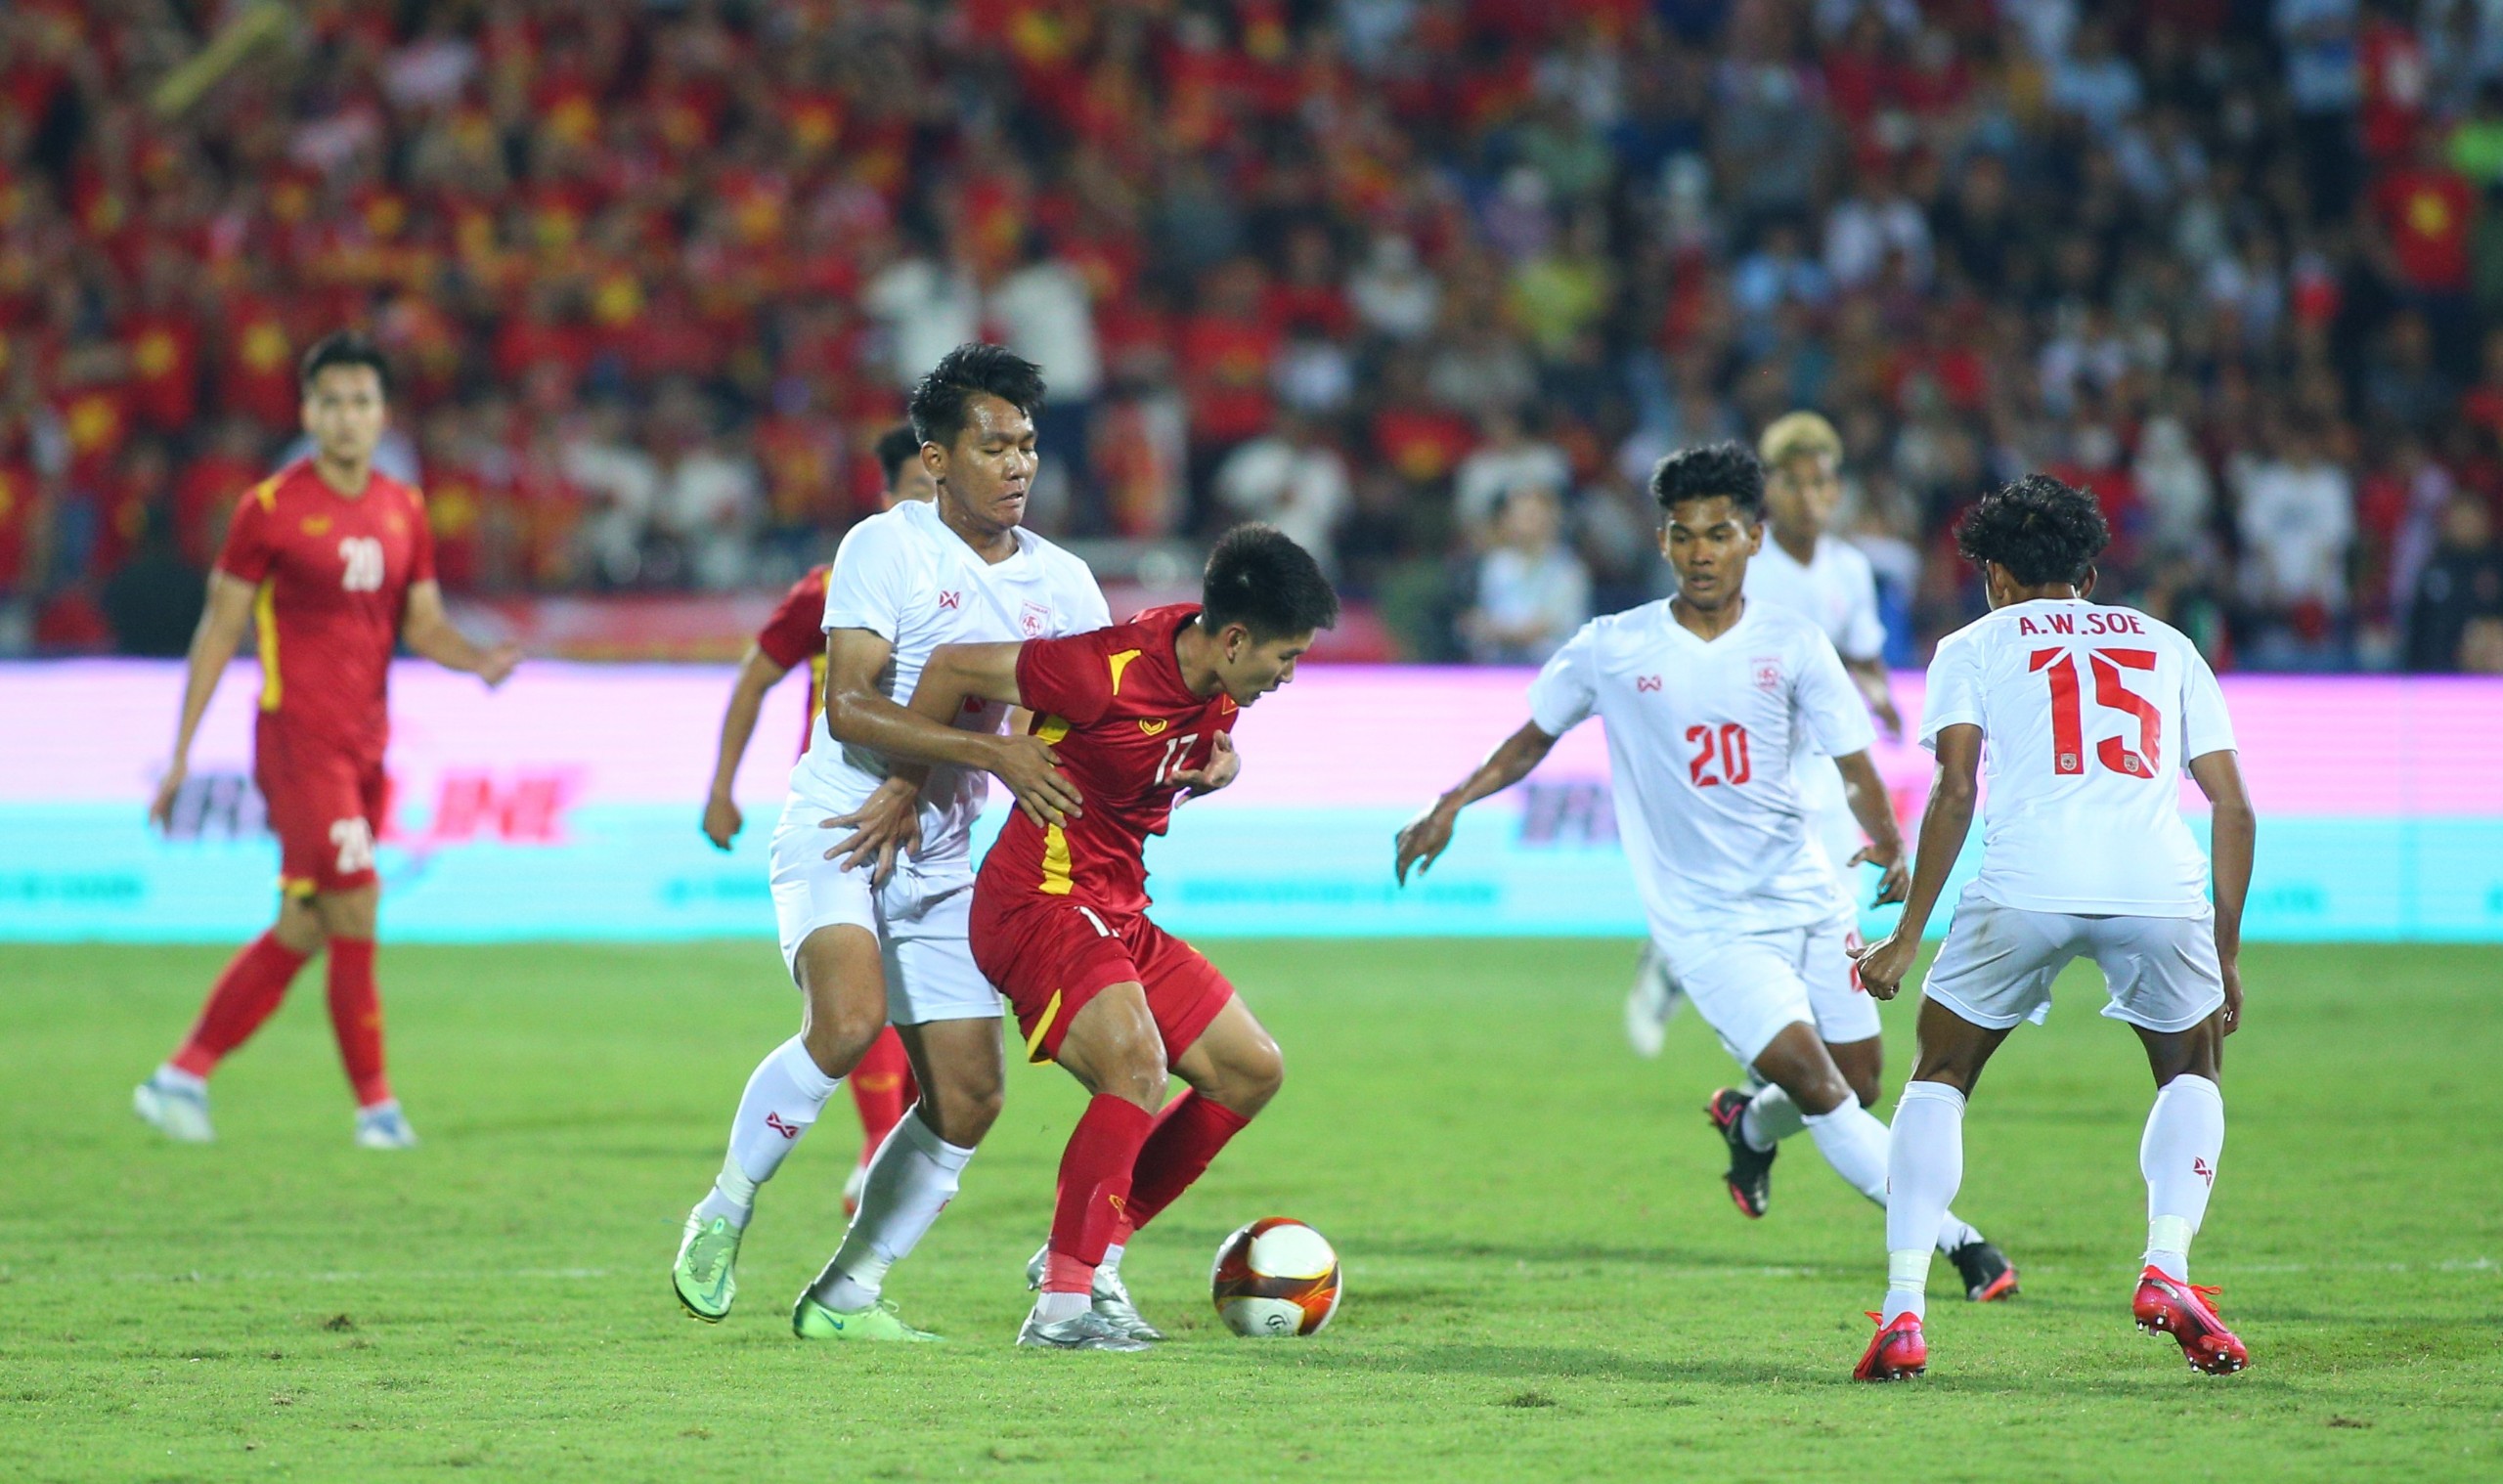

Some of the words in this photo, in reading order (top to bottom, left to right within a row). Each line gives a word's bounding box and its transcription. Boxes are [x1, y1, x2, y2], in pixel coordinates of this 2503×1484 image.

[338, 536, 386, 592] 20
[2019, 613, 2146, 636] A.W.SOE
[2029, 646, 2162, 779] 15
[1154, 733, 1199, 786] 17
[1685, 722, 1750, 788] 20
[1073, 905, 1120, 938] 1
